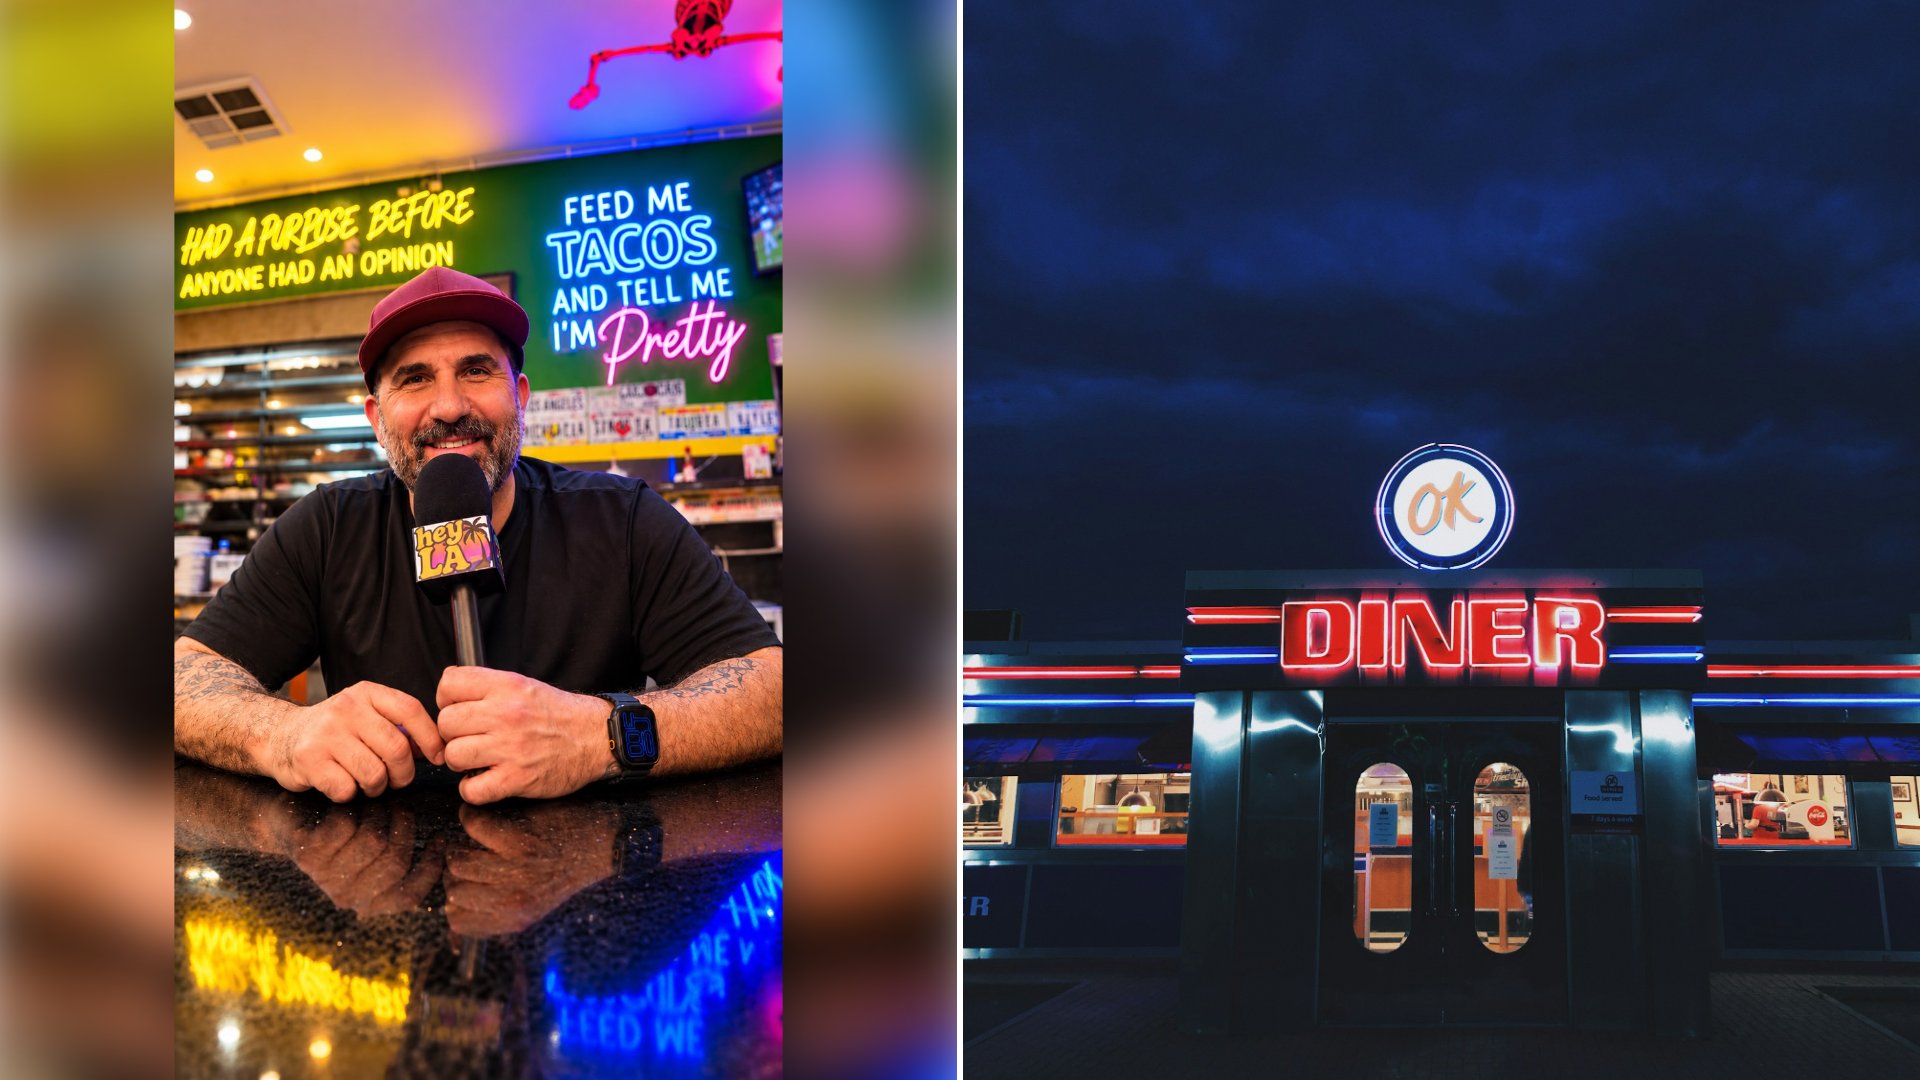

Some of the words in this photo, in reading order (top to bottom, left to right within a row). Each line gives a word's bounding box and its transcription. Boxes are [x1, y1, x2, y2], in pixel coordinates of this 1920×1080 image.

[180, 222, 234, 266] HAD
[234, 217, 257, 257] A
[257, 204, 361, 256] PURPOSE
[366, 187, 476, 242] BEFORE
[564, 189, 635, 226] FEED
[648, 182, 692, 215] ME
[179, 264, 264, 299] ANYONE
[269, 259, 315, 288] HAD
[320, 253, 354, 282] AN
[360, 240, 454, 277] OPINION
[546, 214, 717, 279] TACOS
[552, 284, 608, 316] AND
[616, 275, 682, 307] TELL
[691, 268, 734, 300] ME
[552, 319, 597, 352] I'M
[598, 299, 747, 386] Pretty
[1408, 471, 1484, 536] OK
[415, 519, 463, 552] hey
[418, 544, 471, 580] LA
[1280, 597, 1605, 669] DINER
[963, 896, 990, 916] R
